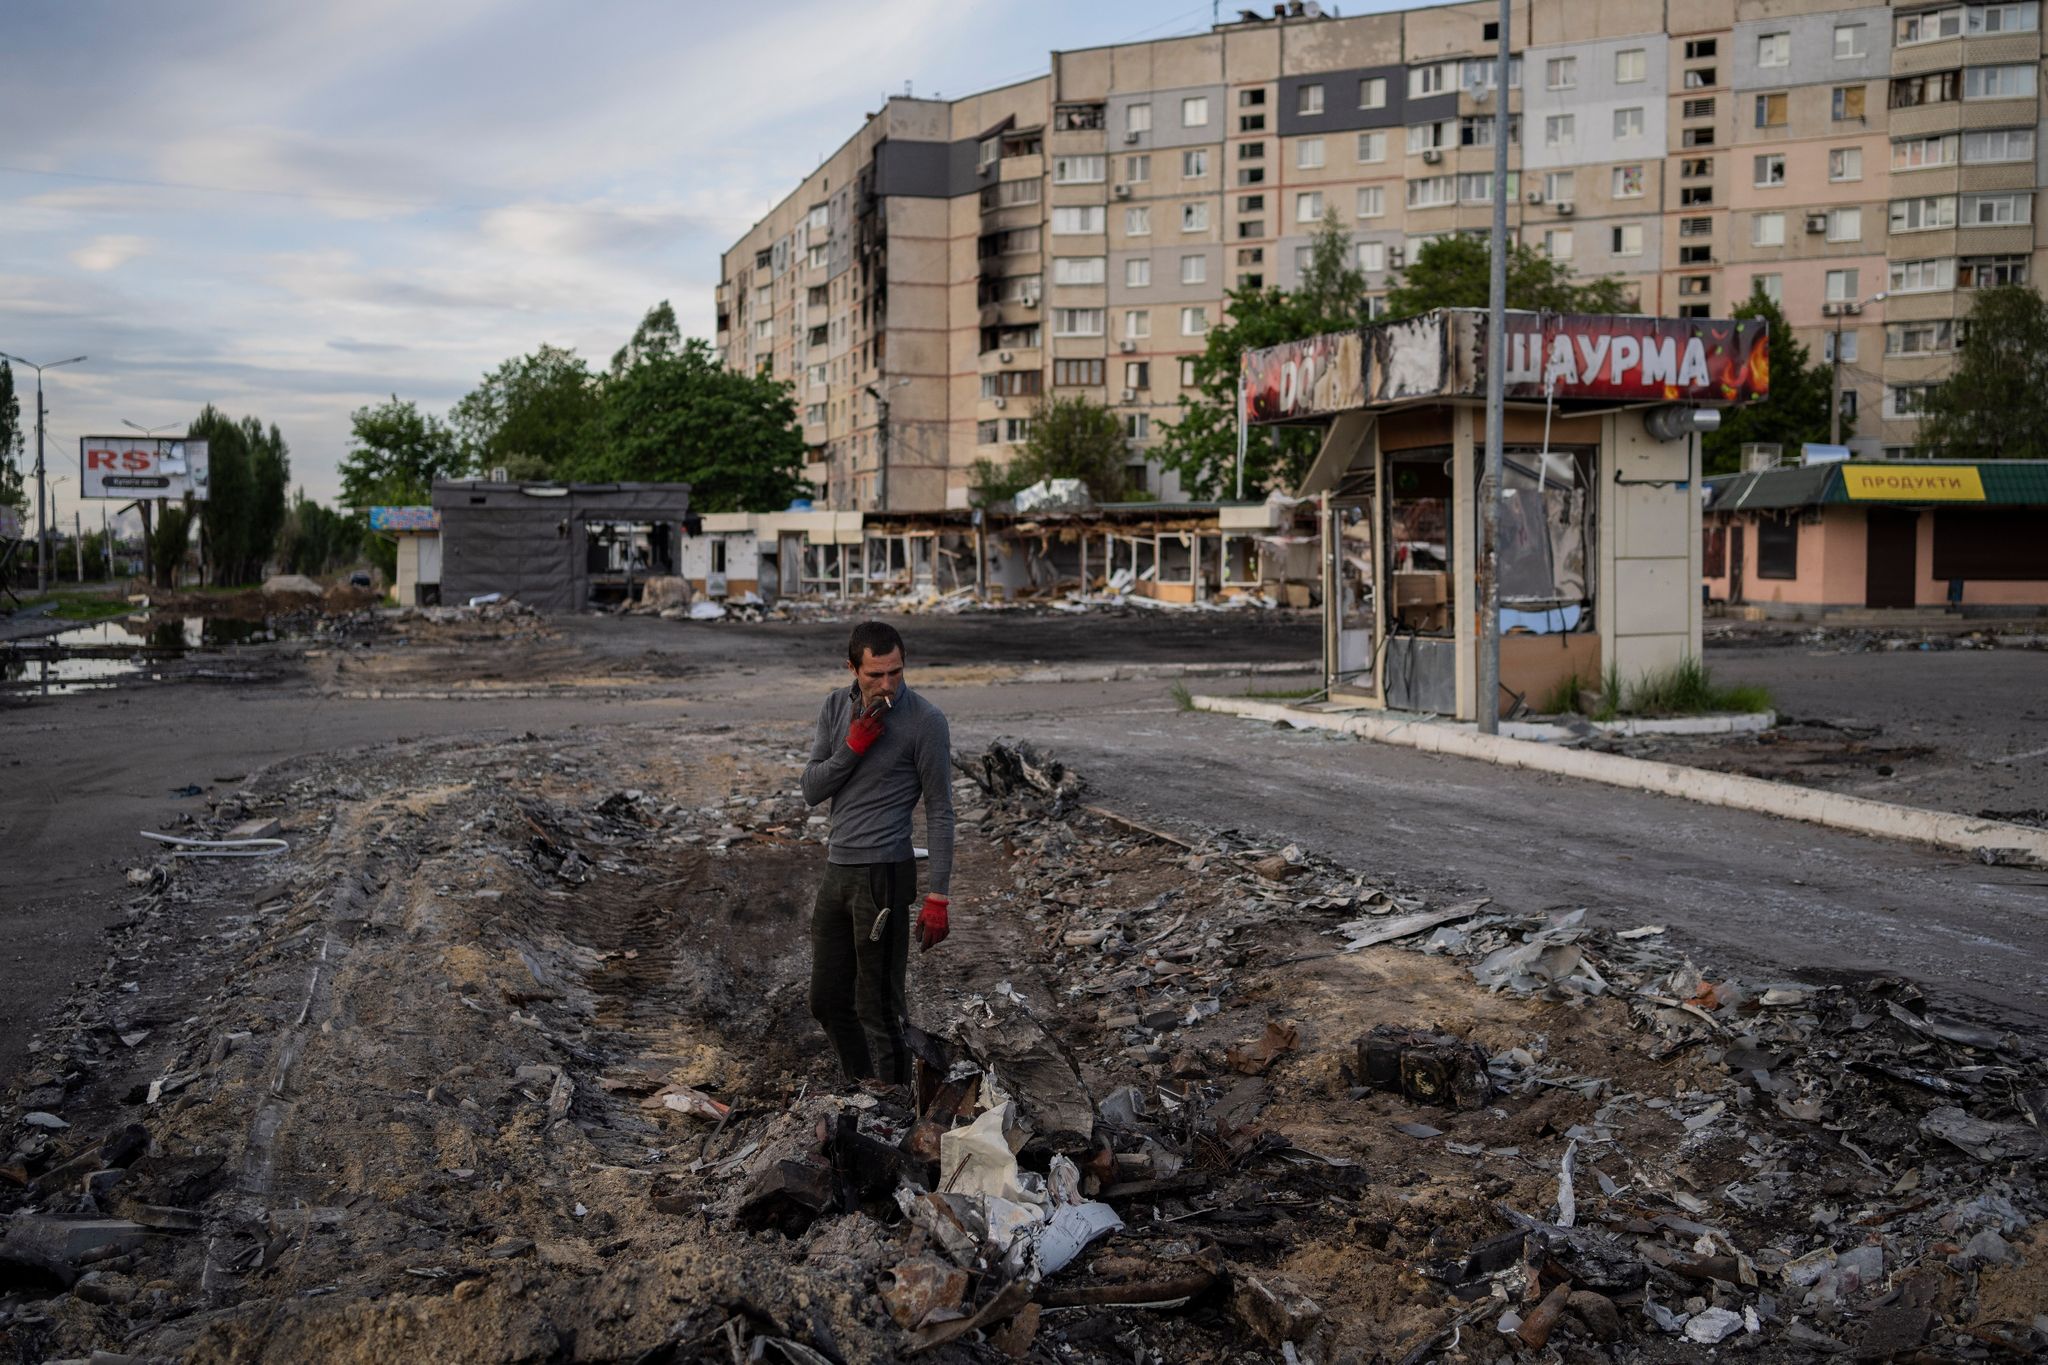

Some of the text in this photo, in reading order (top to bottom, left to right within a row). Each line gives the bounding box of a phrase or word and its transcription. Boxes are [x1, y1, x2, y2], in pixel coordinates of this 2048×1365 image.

[1504, 333, 1710, 387] ШАУРМА
[87, 449, 160, 471] RS
[1861, 475, 1962, 490] ПРОДУКТИ
